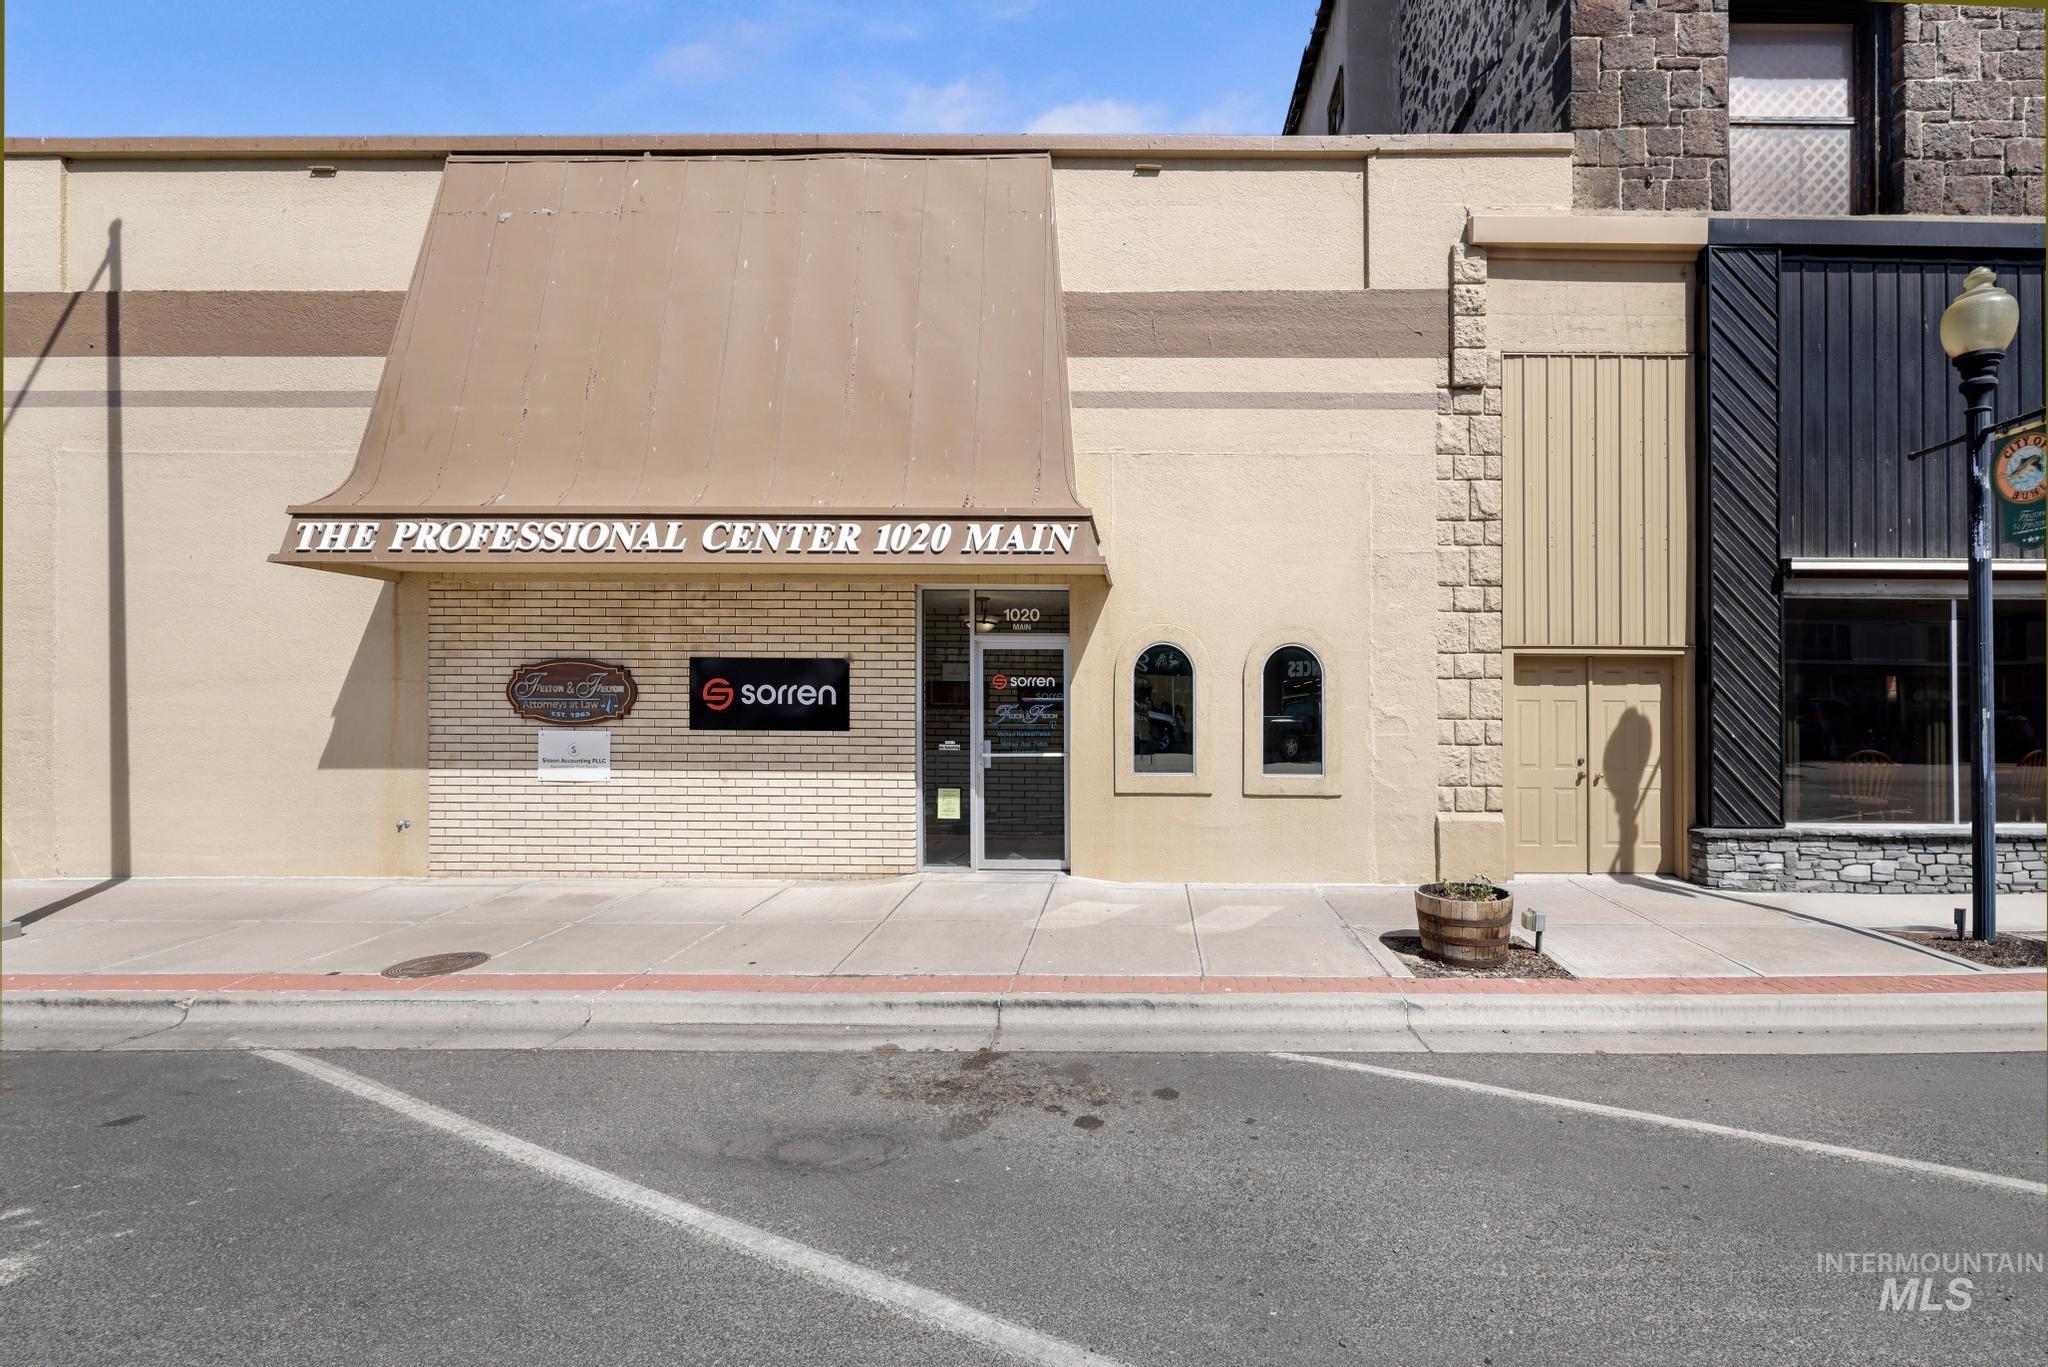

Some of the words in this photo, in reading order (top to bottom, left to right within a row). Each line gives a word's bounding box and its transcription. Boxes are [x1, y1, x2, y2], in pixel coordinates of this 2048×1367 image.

[2004, 436, 2030, 459] CITY
[296, 521, 380, 553] THE
[388, 521, 688, 553] PROFESSIONAL
[702, 522, 862, 554] CENTER
[873, 522, 952, 554] 1020
[961, 523, 1079, 555] MAIN
[1003, 608, 1040, 622] 1020
[567, 682, 575, 693] &
[1010, 676, 1056, 687] sorren
[741, 680, 837, 706] sorren
[523, 701, 567, 710] Attorneys
[581, 701, 599, 709] Law
[561, 757, 592, 765] Accounting
